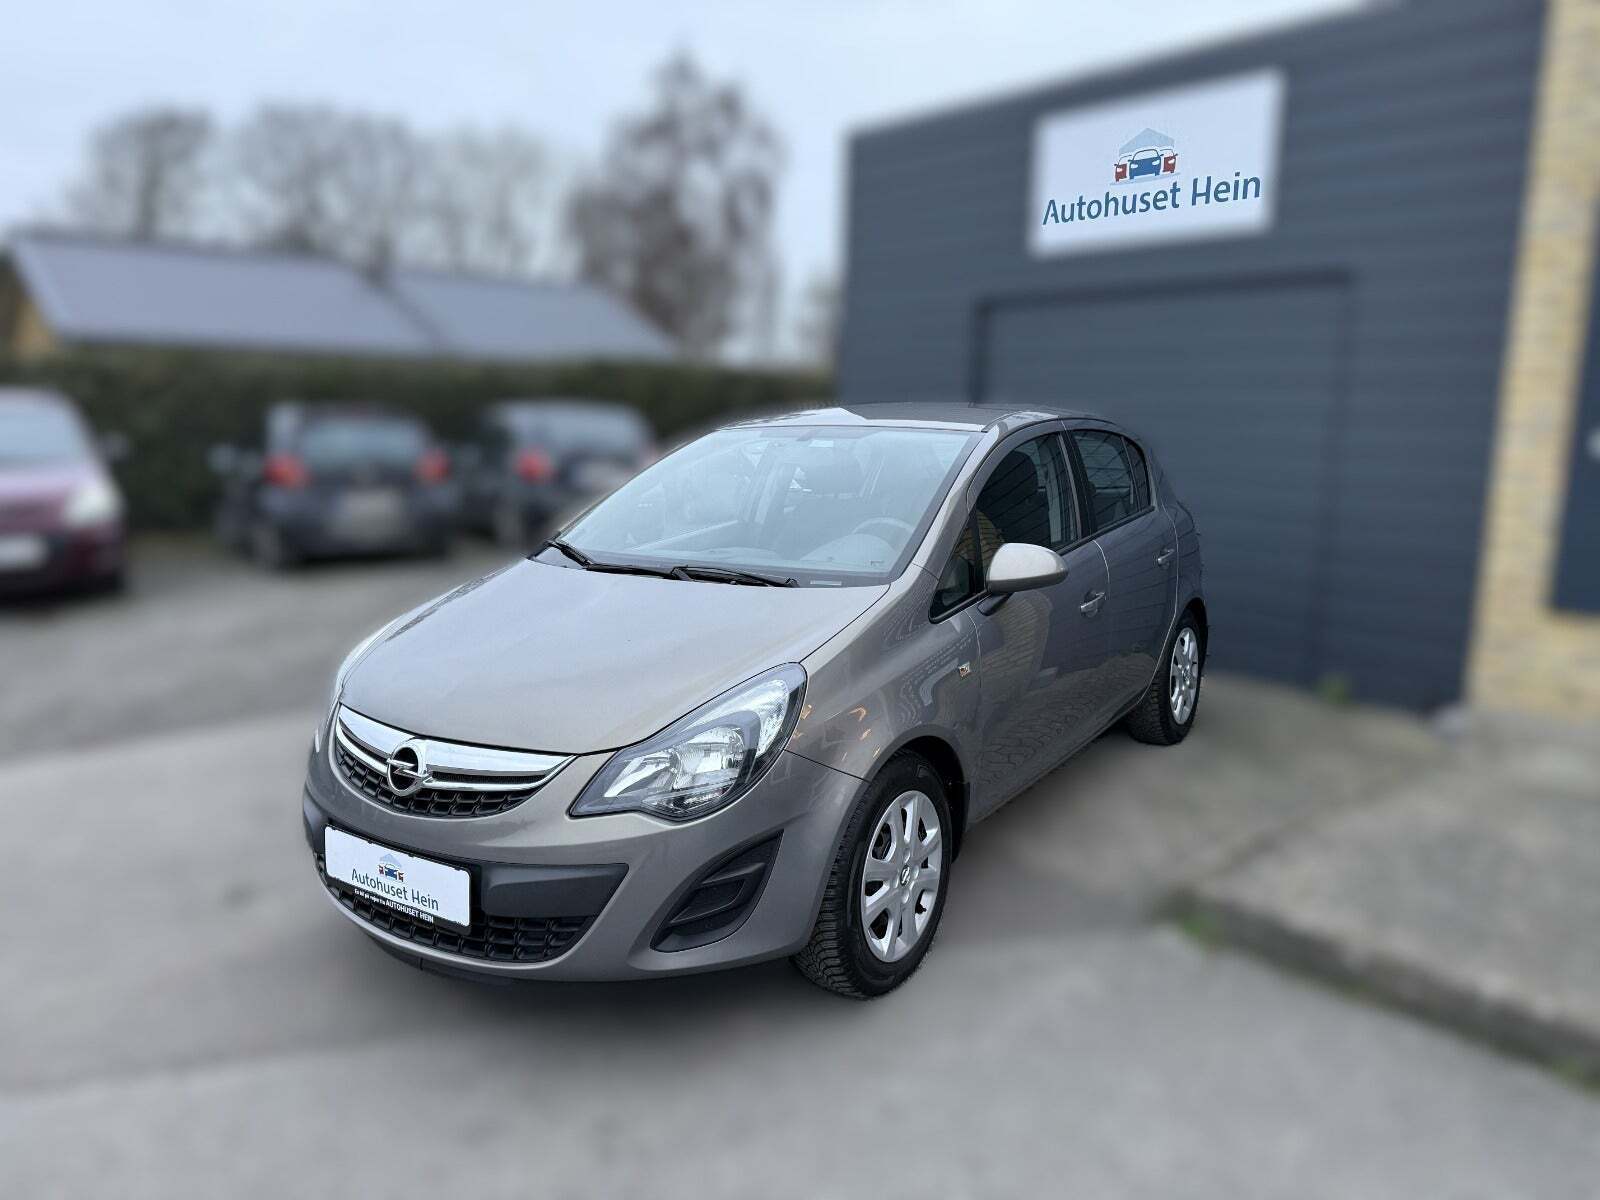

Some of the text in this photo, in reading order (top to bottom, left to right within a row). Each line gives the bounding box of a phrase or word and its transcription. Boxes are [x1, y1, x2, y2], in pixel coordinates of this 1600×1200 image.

[1042, 171, 1262, 226] Autohuset Hein
[351, 868, 439, 911] Autohuset Hein
[385, 899, 419, 918] AUTOHUSET
[419, 911, 434, 924] HEIN
